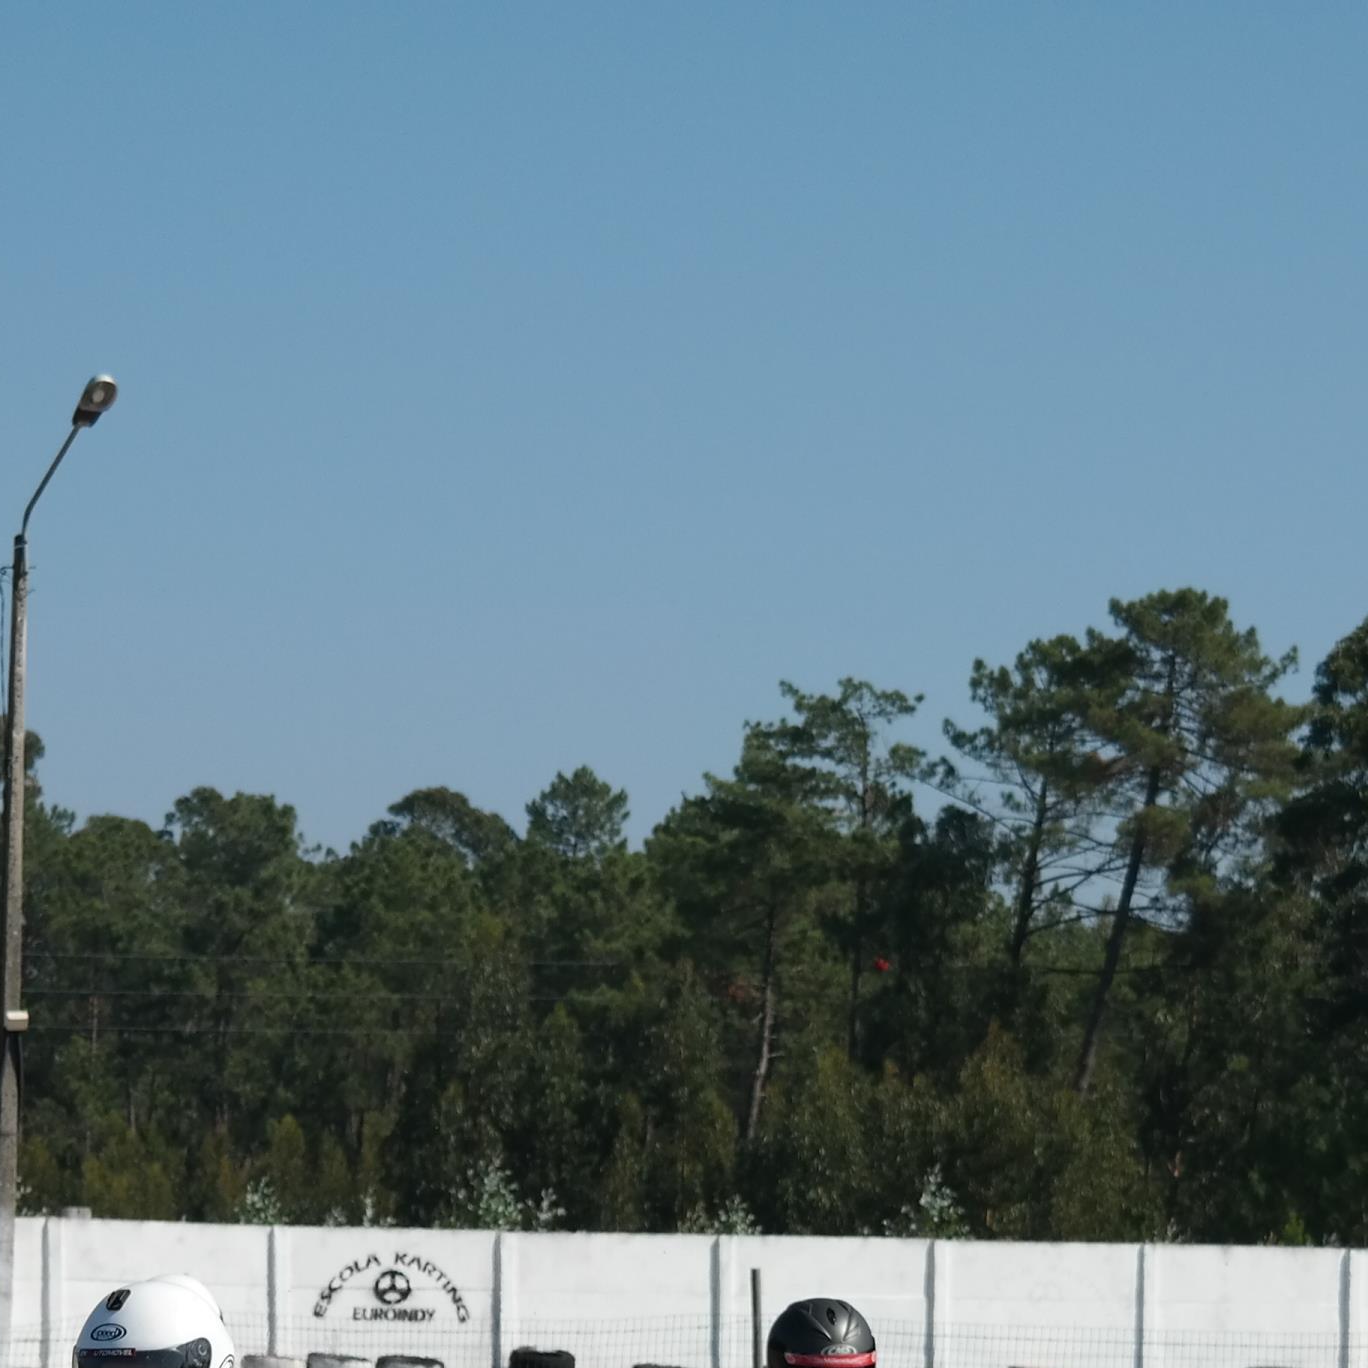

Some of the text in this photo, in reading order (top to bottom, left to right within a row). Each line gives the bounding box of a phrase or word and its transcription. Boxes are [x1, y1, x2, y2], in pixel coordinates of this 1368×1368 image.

[313, 1252, 470, 1323] ESCOLA KARTING
[353, 1307, 436, 1322] EUROINDY
